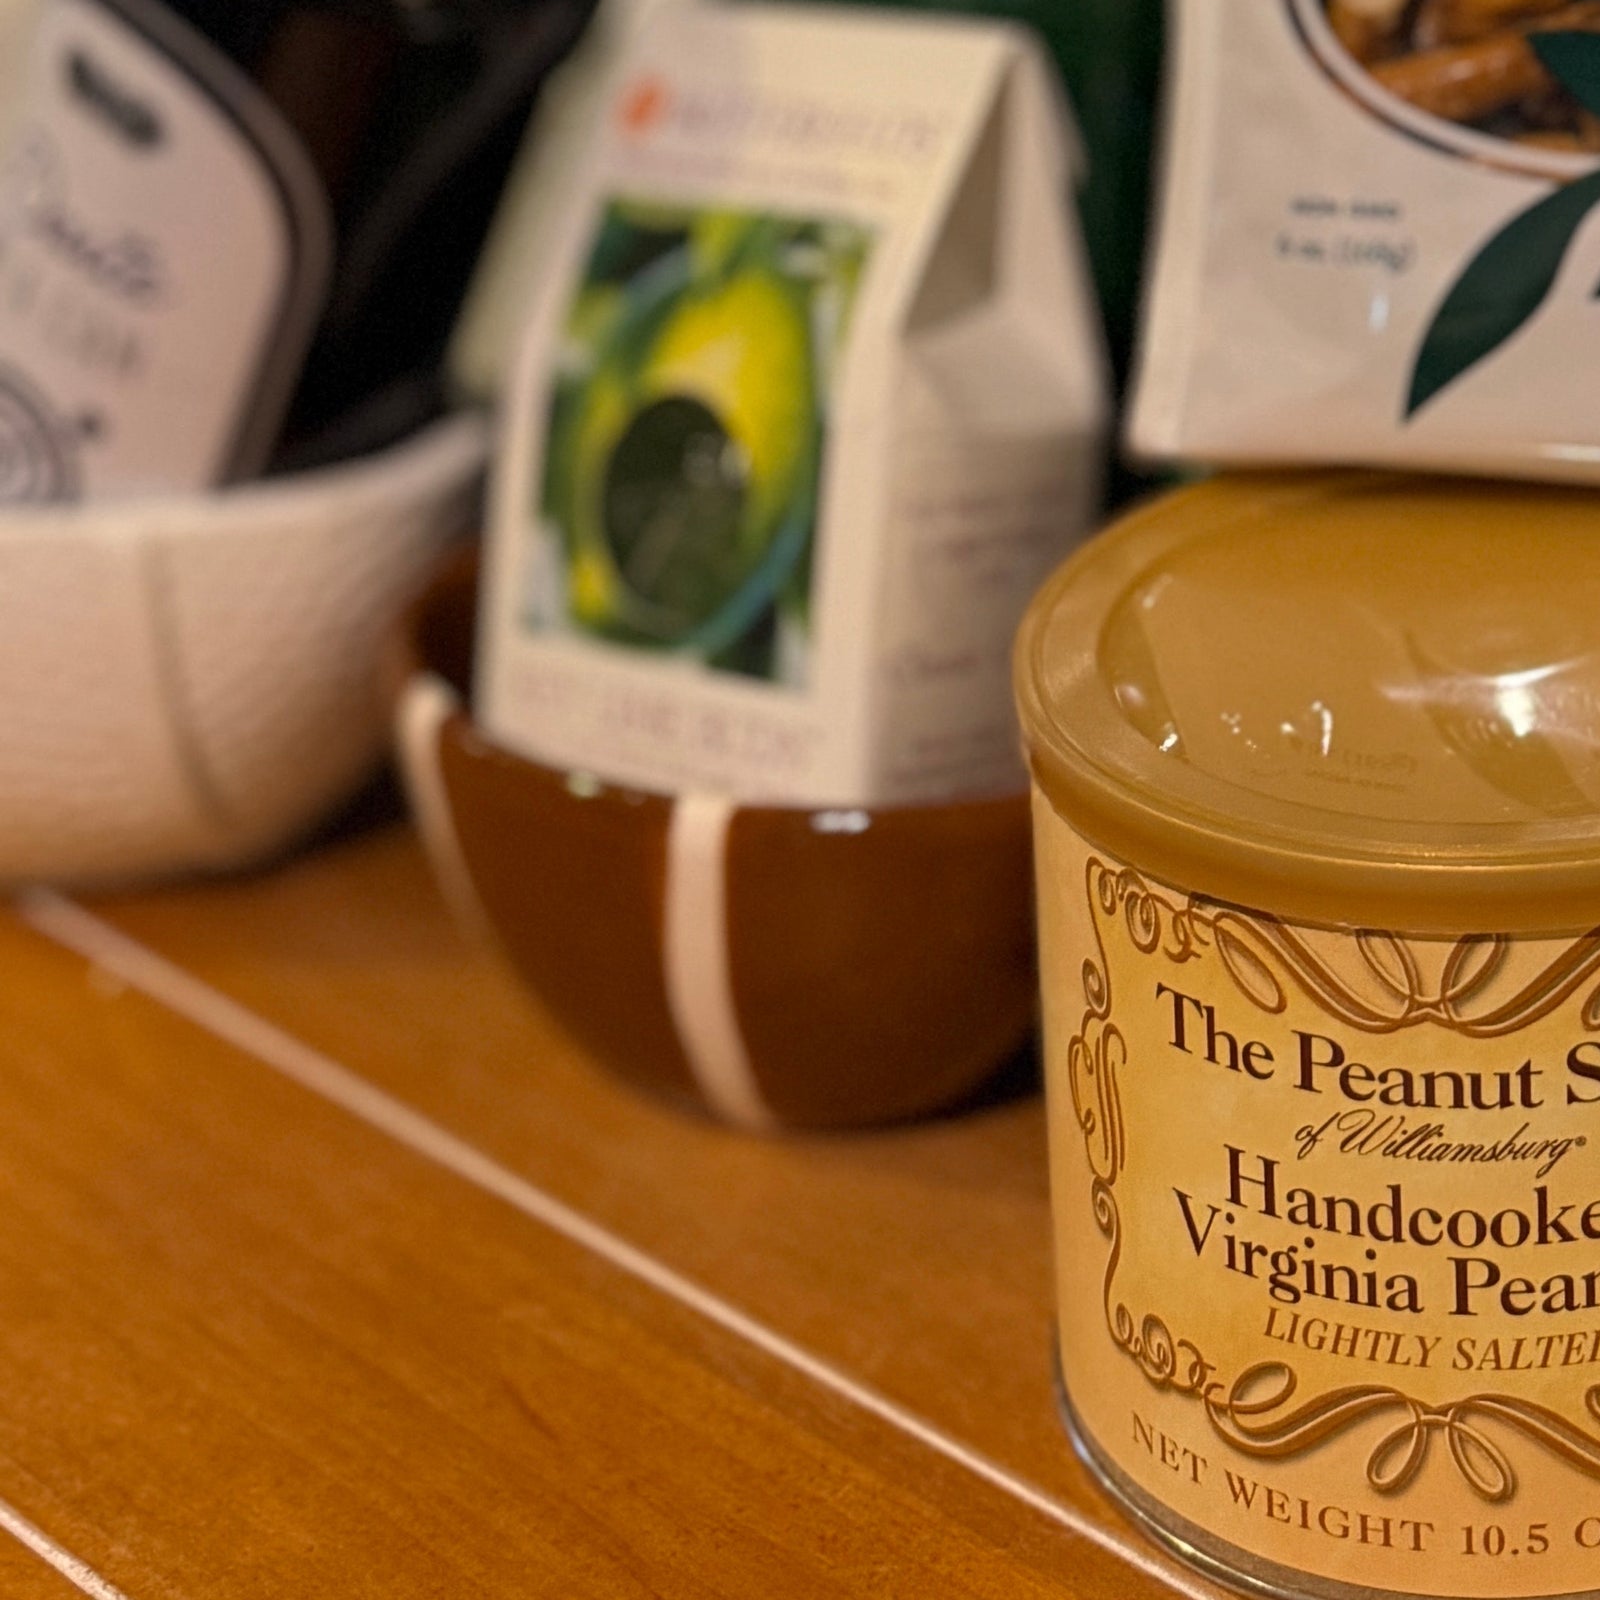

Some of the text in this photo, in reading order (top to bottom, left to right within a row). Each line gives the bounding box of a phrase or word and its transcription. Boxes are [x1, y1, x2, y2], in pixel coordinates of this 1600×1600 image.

[1156, 983, 1275, 1081] The
[1292, 1029, 1543, 1110] Peanut
[1295, 1110, 1334, 1160] of
[1173, 1186, 1425, 1314] Virginia
[1263, 1307, 1443, 1369] LIGHTLY
[1132, 1411, 1208, 1485] NET
[1224, 1469, 1435, 1552] WEIGHT
[1460, 1522, 1550, 1556] 10.5
